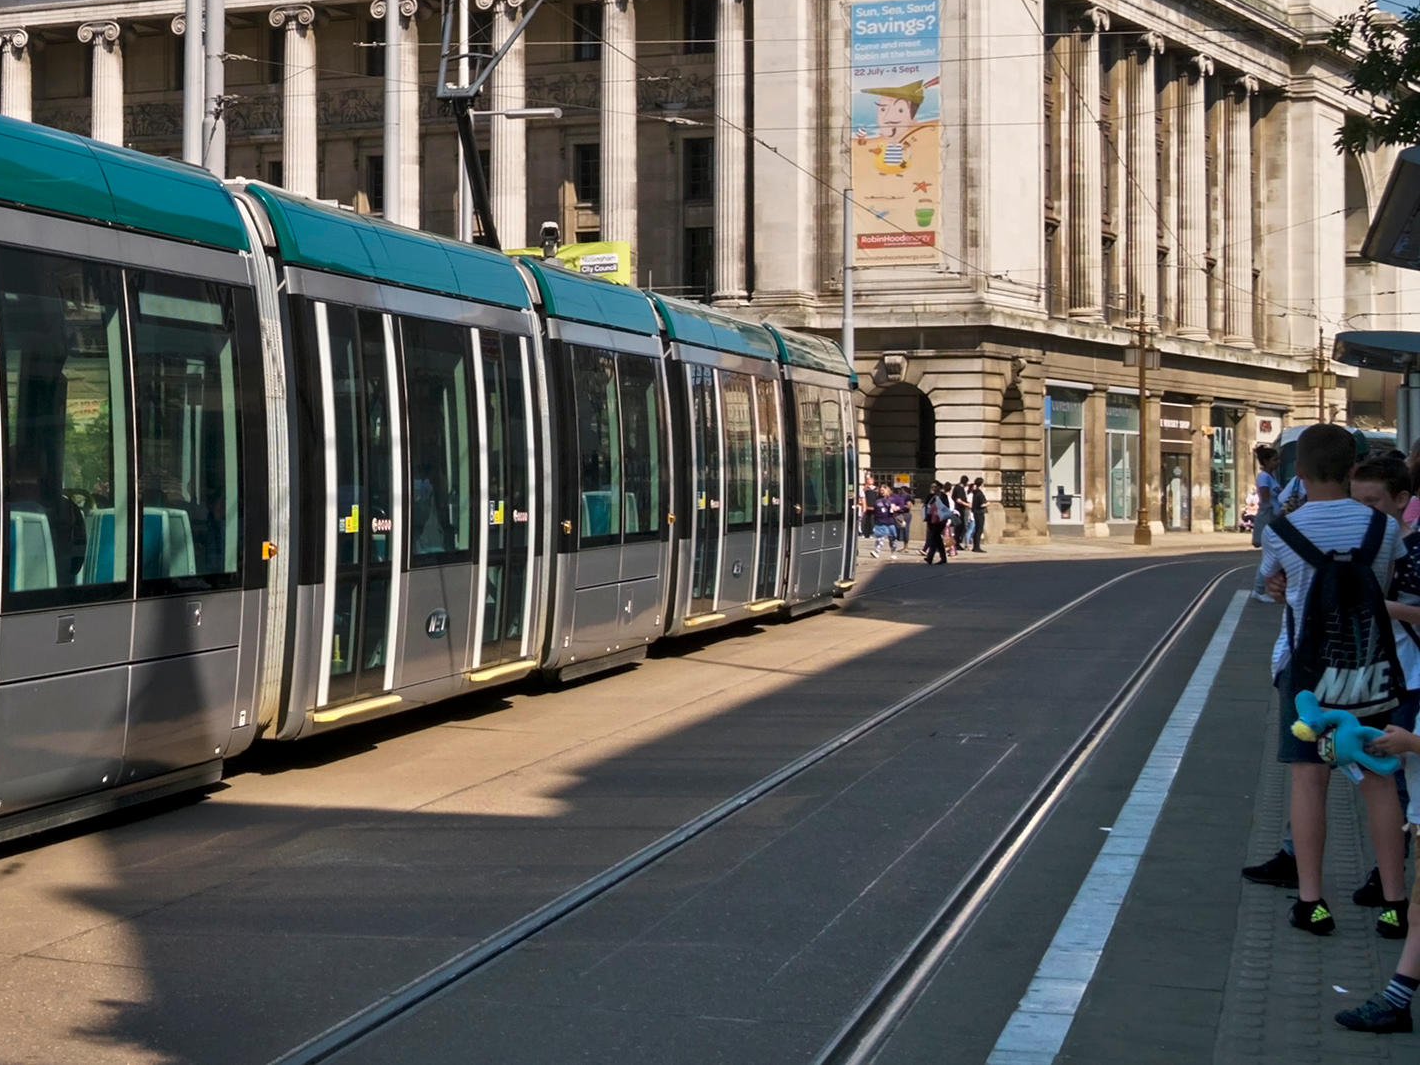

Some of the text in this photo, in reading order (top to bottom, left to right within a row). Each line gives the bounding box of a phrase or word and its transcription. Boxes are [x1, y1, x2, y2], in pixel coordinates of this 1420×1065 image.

[907, 1, 935, 13] Sand
[855, 15, 935, 35] Savings?
[854, 68, 866, 77] 22
[867, 67, 885, 76] July
[899, 65, 920, 75] Sept
[594, 264, 617, 272] Council
[1314, 661, 1390, 705] NIKE
